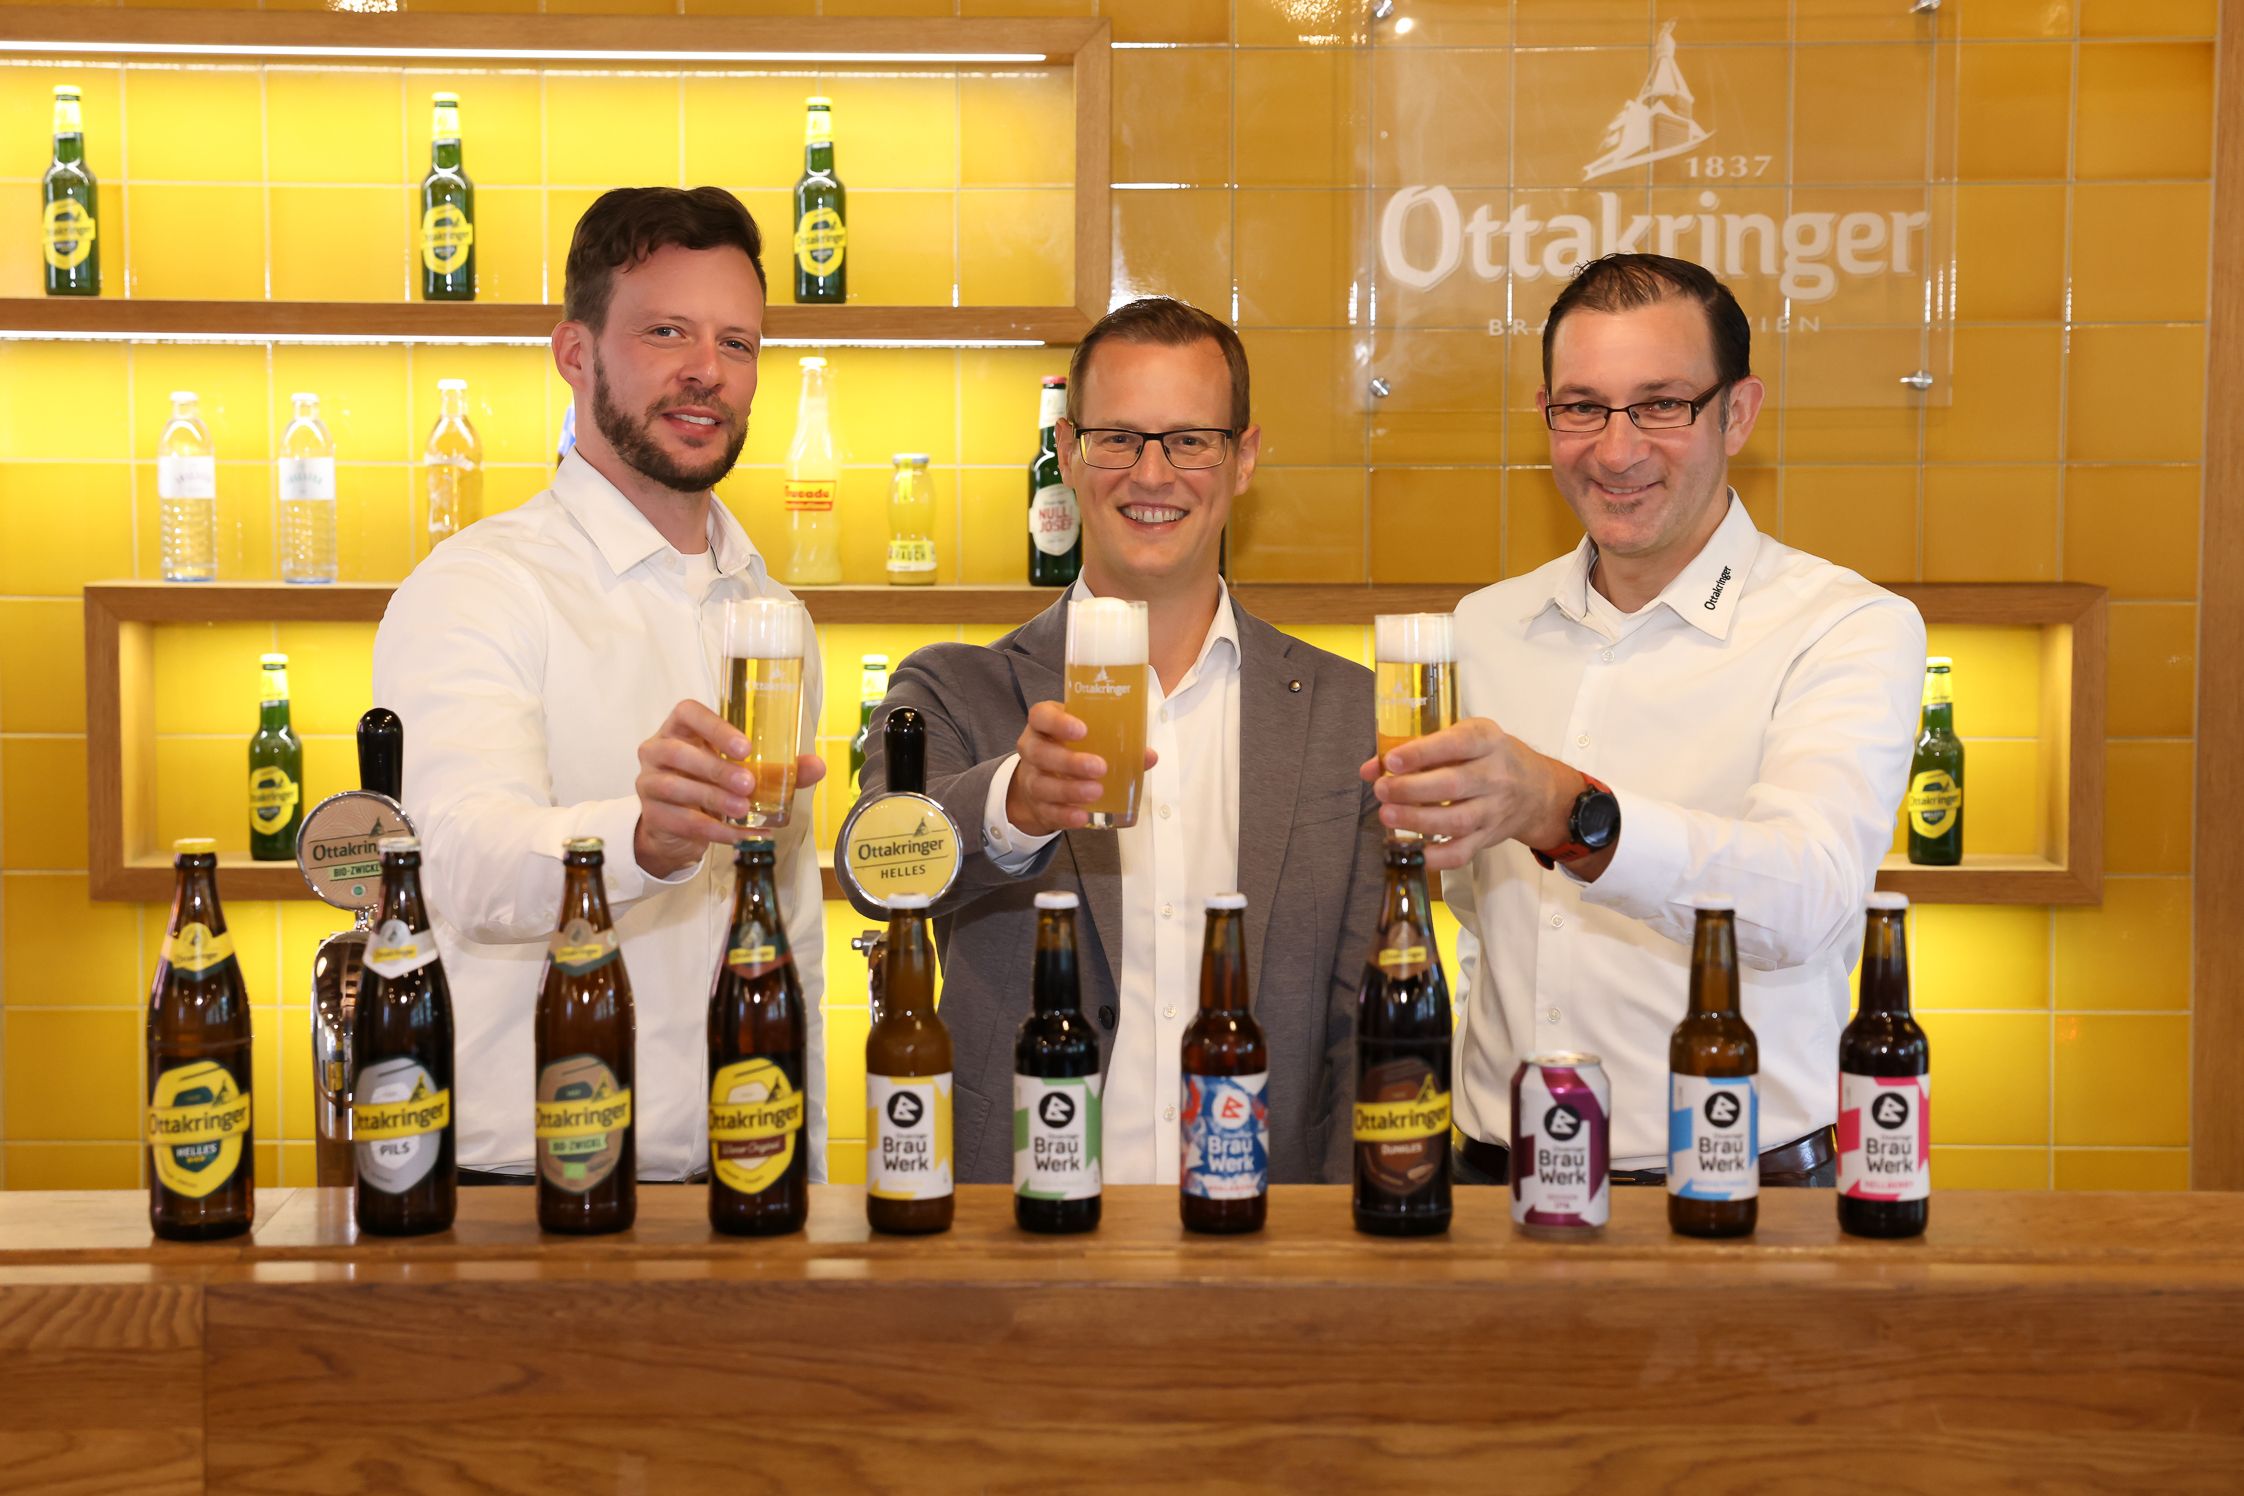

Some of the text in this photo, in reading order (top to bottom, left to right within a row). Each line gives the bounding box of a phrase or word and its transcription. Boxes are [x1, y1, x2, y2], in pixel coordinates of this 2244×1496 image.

[1684, 155, 1773, 178] 1837
[1379, 184, 1931, 302] Ottakringer
[1703, 565, 1732, 610] Ottakringer
[312, 838, 380, 862] Ottakrin
[858, 839, 945, 861] Ottakringer
[880, 864, 926, 879] HELLES
[150, 1106, 246, 1135] Ottakringer
[353, 1102, 445, 1130] Ottakringer
[536, 1101, 626, 1129] Ottakringer
[709, 1103, 799, 1130] Ottakringer
[1355, 1105, 1448, 1132] Ottakringer
[175, 1142, 218, 1158] HELLES
[379, 1141, 411, 1156] PILS
[882, 1136, 927, 1153] Brau
[1034, 1137, 1079, 1154] Brau
[1207, 1135, 1253, 1154] Brau
[1699, 1137, 1744, 1154] Brau
[1866, 1138, 1912, 1154] Brau
[883, 1155, 929, 1172] Werk
[1034, 1155, 1080, 1172] Werk
[1208, 1155, 1255, 1172] Werk
[1538, 1150, 1585, 1167] Brau
[1699, 1155, 1745, 1172] Werk
[1866, 1155, 1914, 1174] Werk
[1539, 1169, 1587, 1185] Werk
